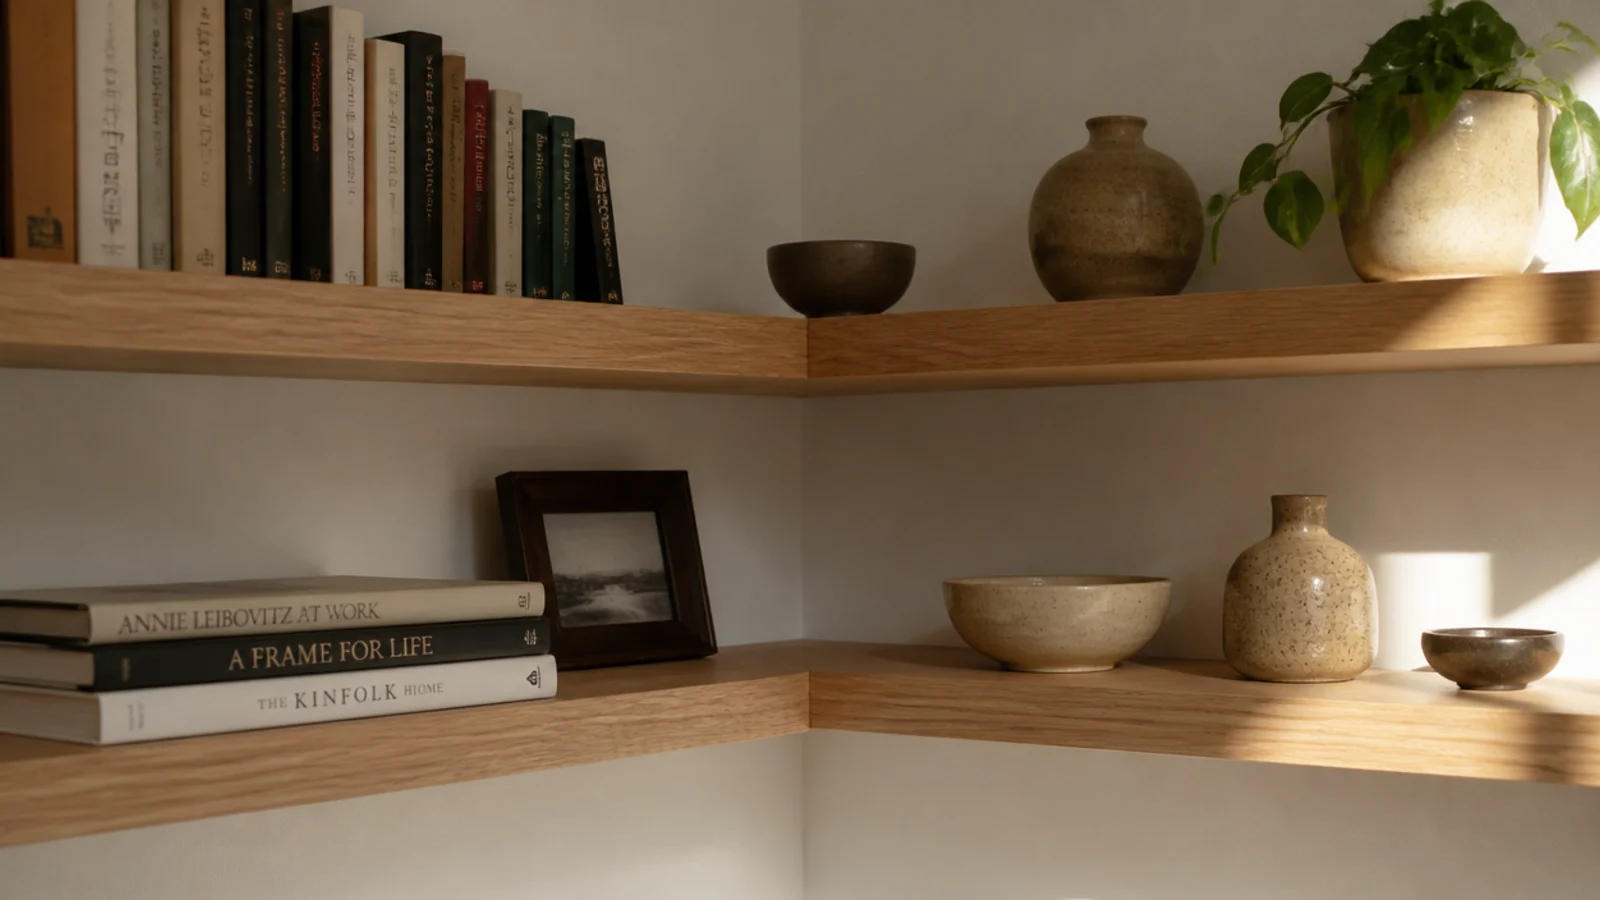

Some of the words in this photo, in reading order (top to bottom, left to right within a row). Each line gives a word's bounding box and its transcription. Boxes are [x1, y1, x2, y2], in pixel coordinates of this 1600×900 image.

[119, 611, 188, 635] ANNIE
[193, 605, 293, 630] LEIBOVITZ
[297, 604, 321, 624] AT
[324, 601, 380, 621] WORK
[228, 648, 245, 671] A
[251, 642, 333, 669] FRAME
[339, 639, 384, 662] FOR
[390, 635, 434, 658] LIFE
[257, 697, 288, 710] THE
[294, 683, 398, 710] KINFOLK
